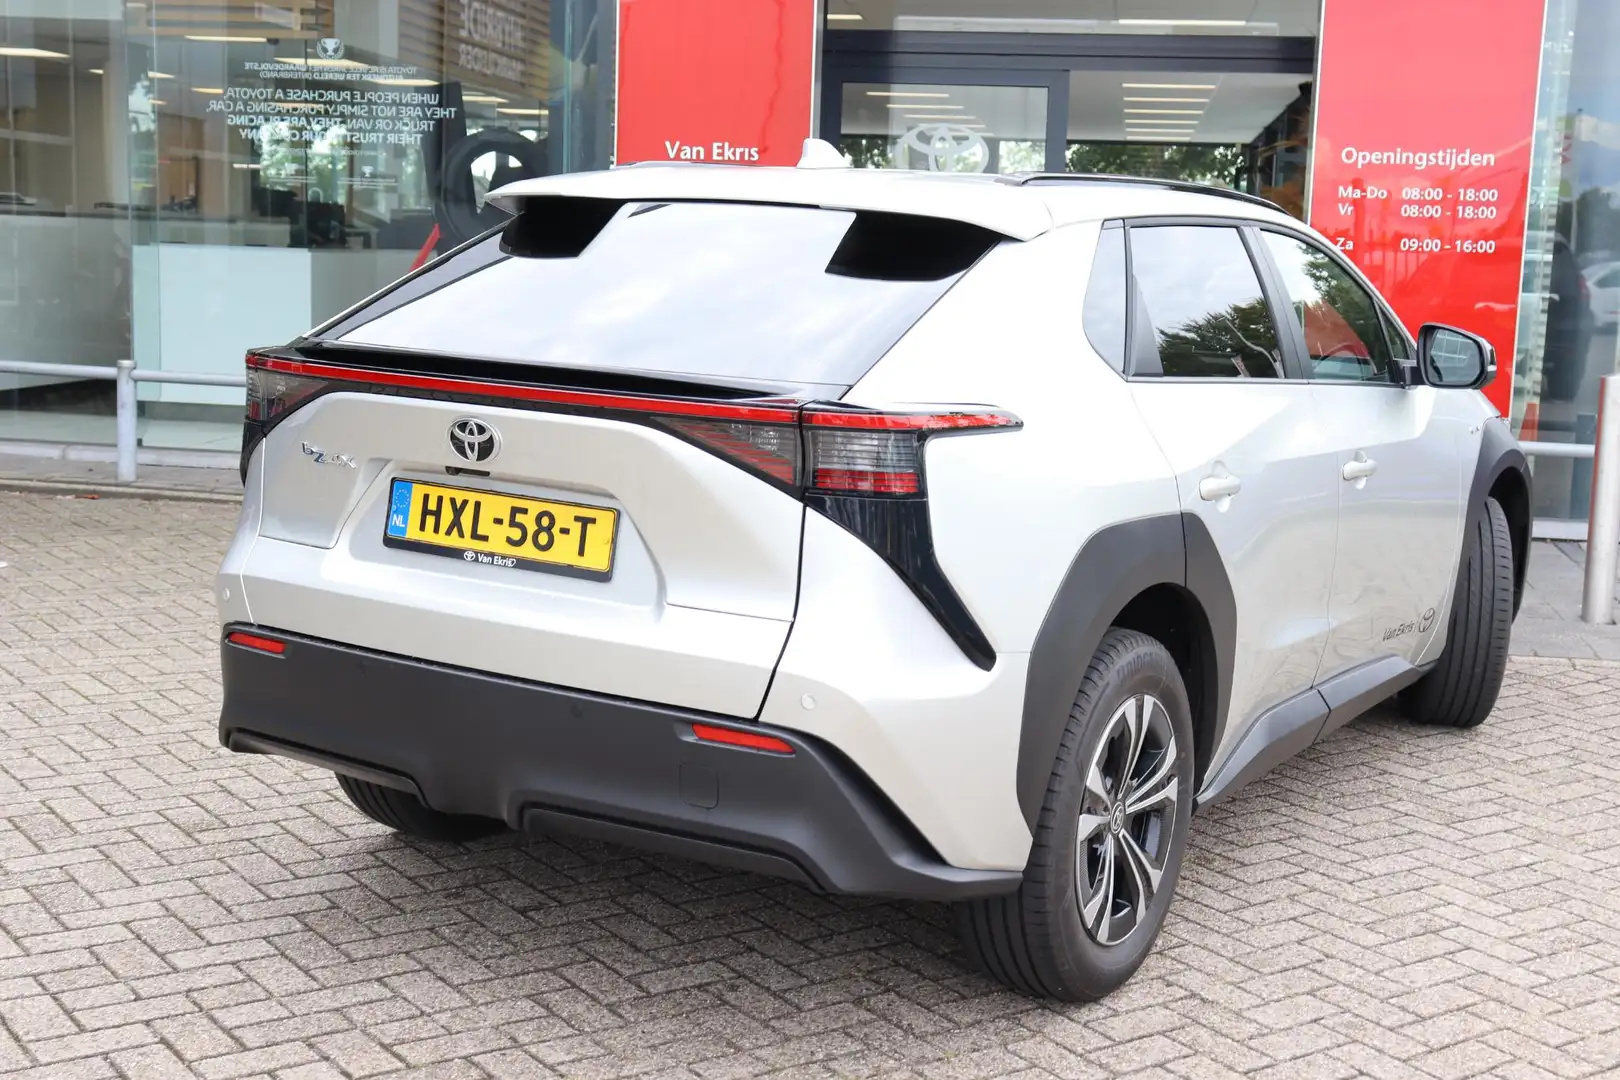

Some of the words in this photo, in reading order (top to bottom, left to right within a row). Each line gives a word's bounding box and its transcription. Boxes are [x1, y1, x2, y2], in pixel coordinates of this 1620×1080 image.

[664, 140, 705, 160] Van
[712, 141, 759, 161] Ekris
[1341, 147, 1496, 170] Openingstijden
[1338, 186, 1388, 199] Ma-Do
[1402, 187, 1443, 200] 08:00
[1457, 188, 1499, 202] 18:00
[1338, 203, 1355, 216] Vr
[1400, 204, 1442, 218] 08:00
[1456, 205, 1497, 219] 18:00
[1335, 237, 1354, 251] Za
[1400, 238, 1441, 252] 09:00
[1455, 239, 1496, 253] 16:00
[391, 514, 406, 528] NL
[419, 492, 597, 558] HXL-58-T
[477, 552, 492, 564] Van
[493, 555, 513, 567] Ekris
[1382, 627, 1396, 642] Van
[1395, 620, 1415, 637] Ekris
